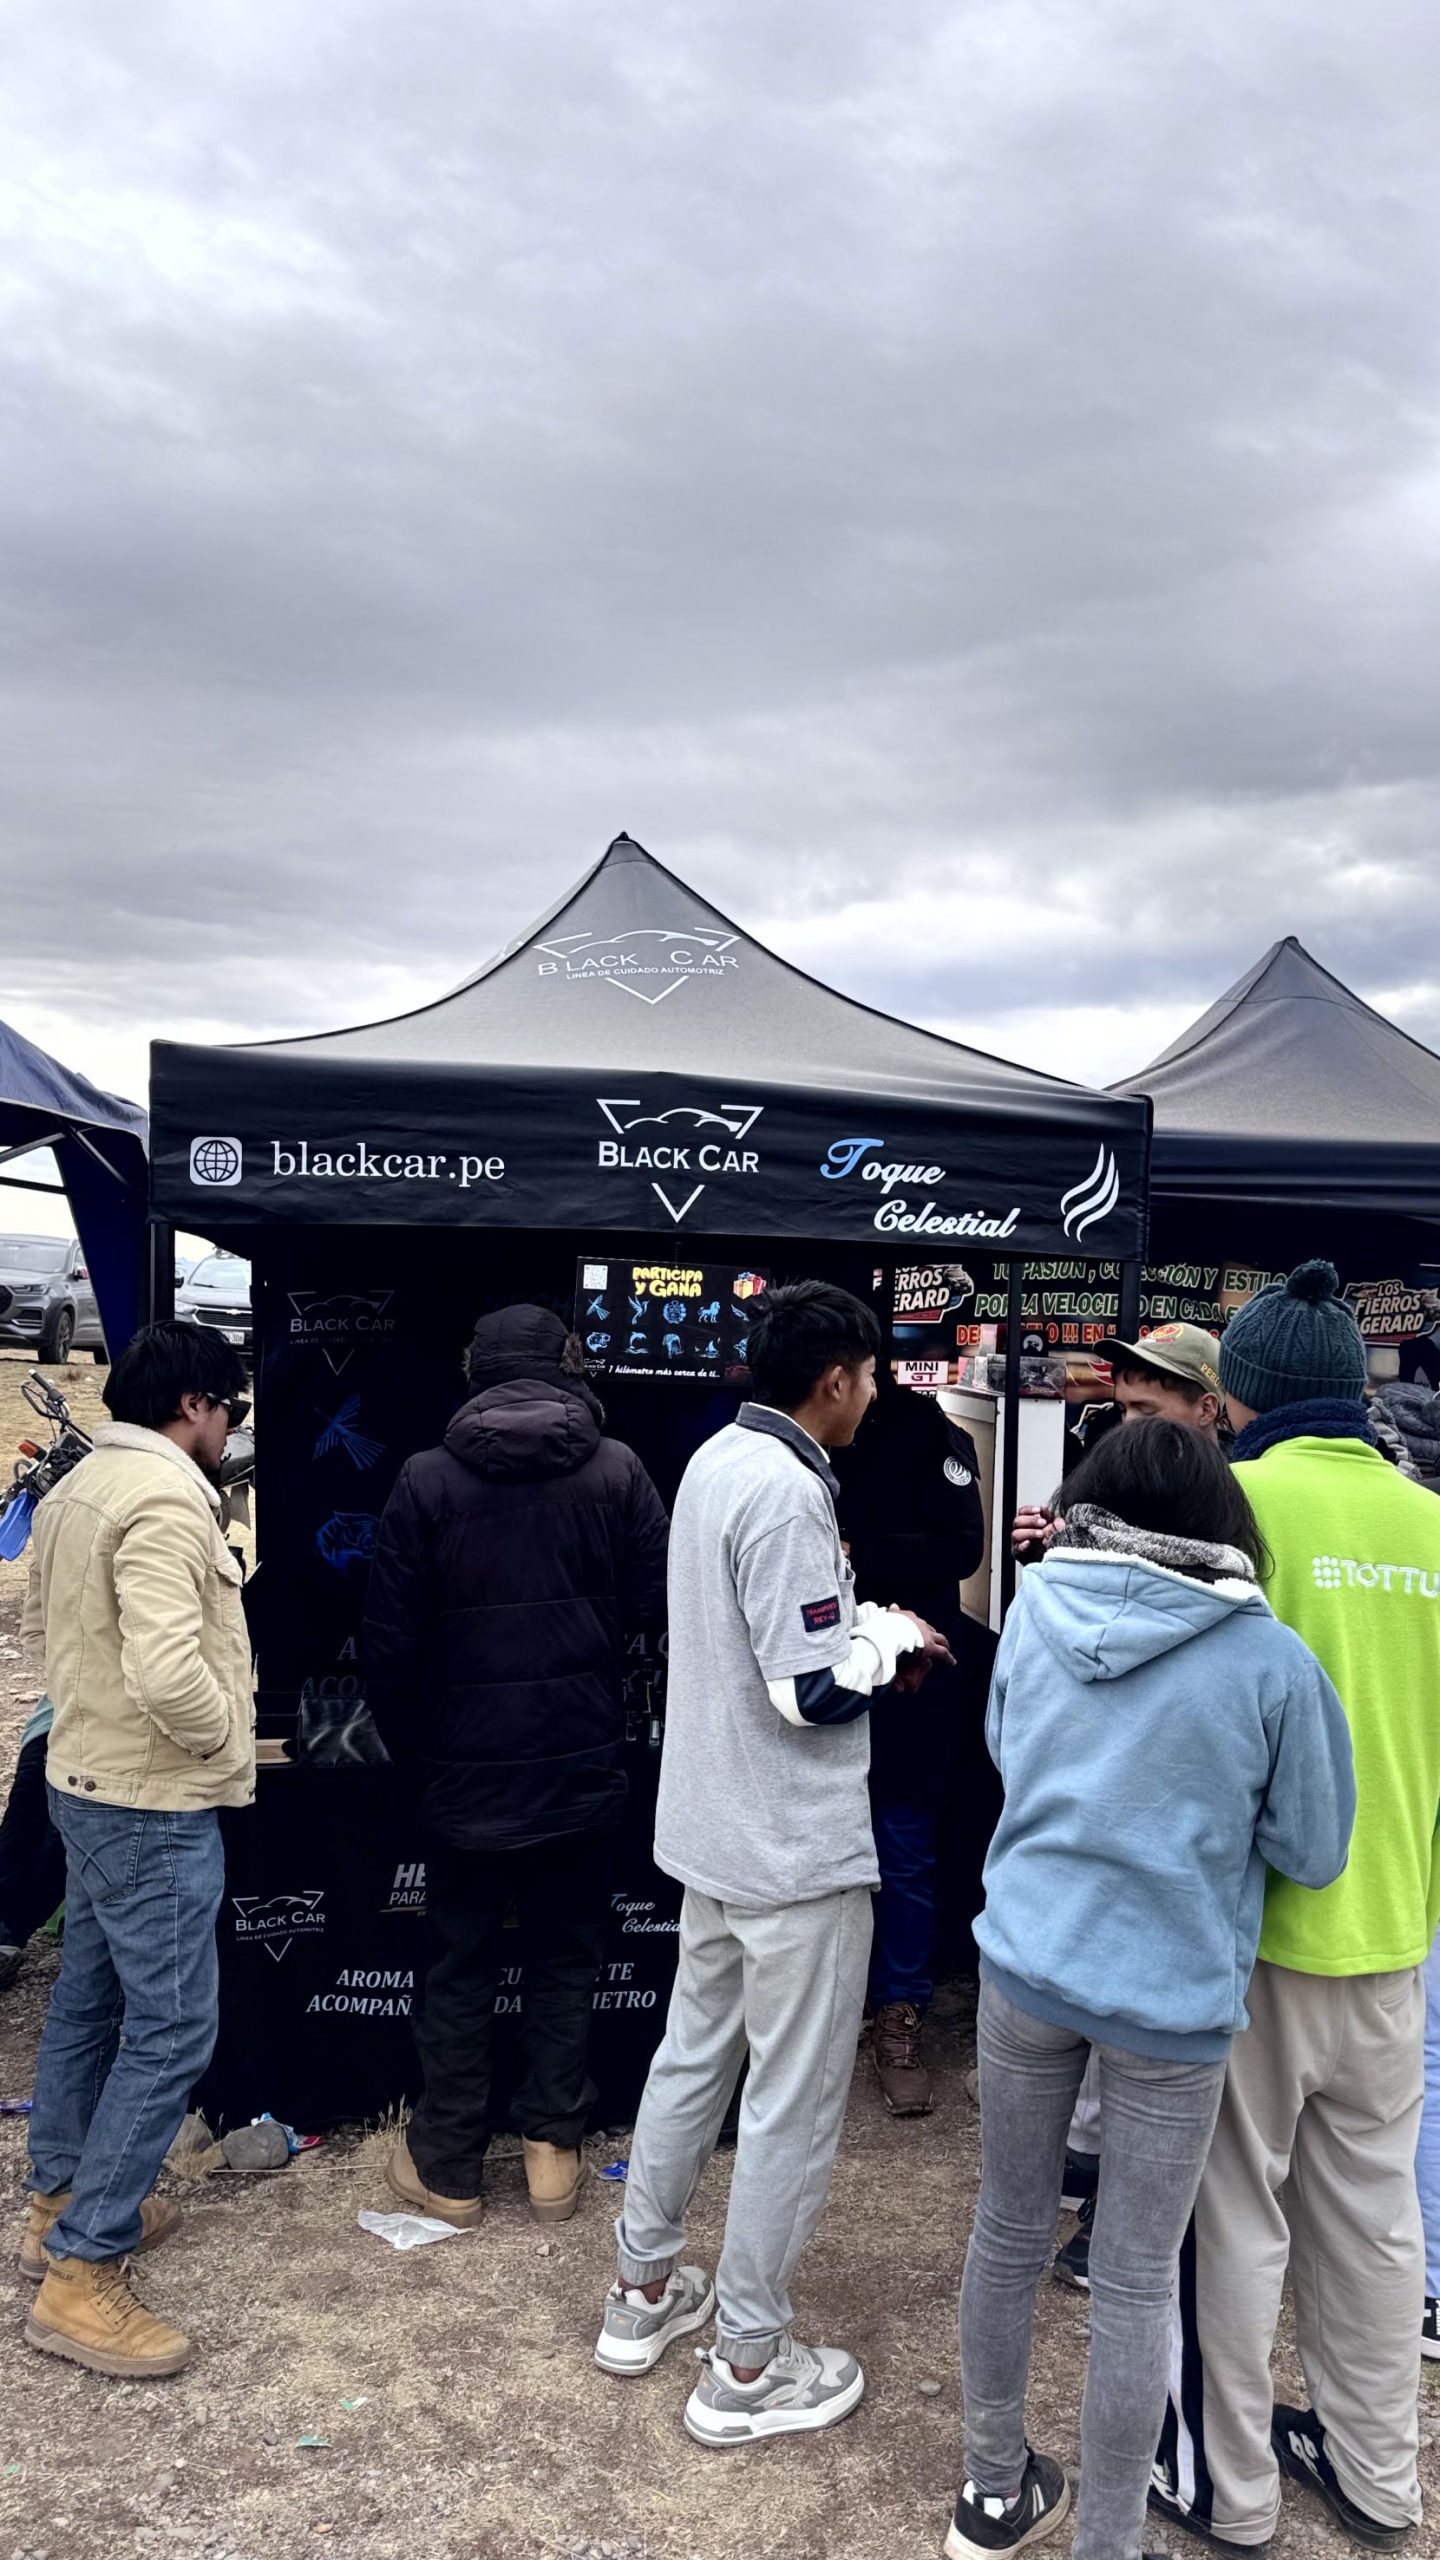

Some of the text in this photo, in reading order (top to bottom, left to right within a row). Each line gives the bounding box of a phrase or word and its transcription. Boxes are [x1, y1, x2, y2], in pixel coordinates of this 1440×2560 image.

[670, 950, 740, 968] CAR
[597, 969, 611, 977] DE
[613, 966, 659, 975] CUIDADO
[661, 966, 725, 976] AUTOMOTRIZ
[270, 1141, 506, 1188] blackcar.pe
[598, 1140, 760, 1173] BLACK CAR
[819, 1137, 946, 1194] Toque
[873, 1199, 1022, 1239] Celestial
[632, 1267, 703, 1282] PARTICIPA
[1203, 1267, 1218, 1290] Y
[649, 1280, 702, 1297] GANA
[1378, 1282, 1401, 1297] LOS
[1150, 1295, 1177, 1319] EN
[289, 1315, 396, 1333] BLACK CAR
[1082, 1323, 1104, 1344] EN
[1360, 1313, 1424, 1335] GERARD
[697, 1368, 707, 1377] de
[905, 1362, 938, 1371] MINI
[911, 1372, 937, 1382] GT
[235, 1911, 326, 1932] BLACK CAR
[621, 1917, 680, 1933] Celestia
[335, 1968, 414, 1988] AROMA
[305, 1994, 413, 2016] ACOMPAÑ
